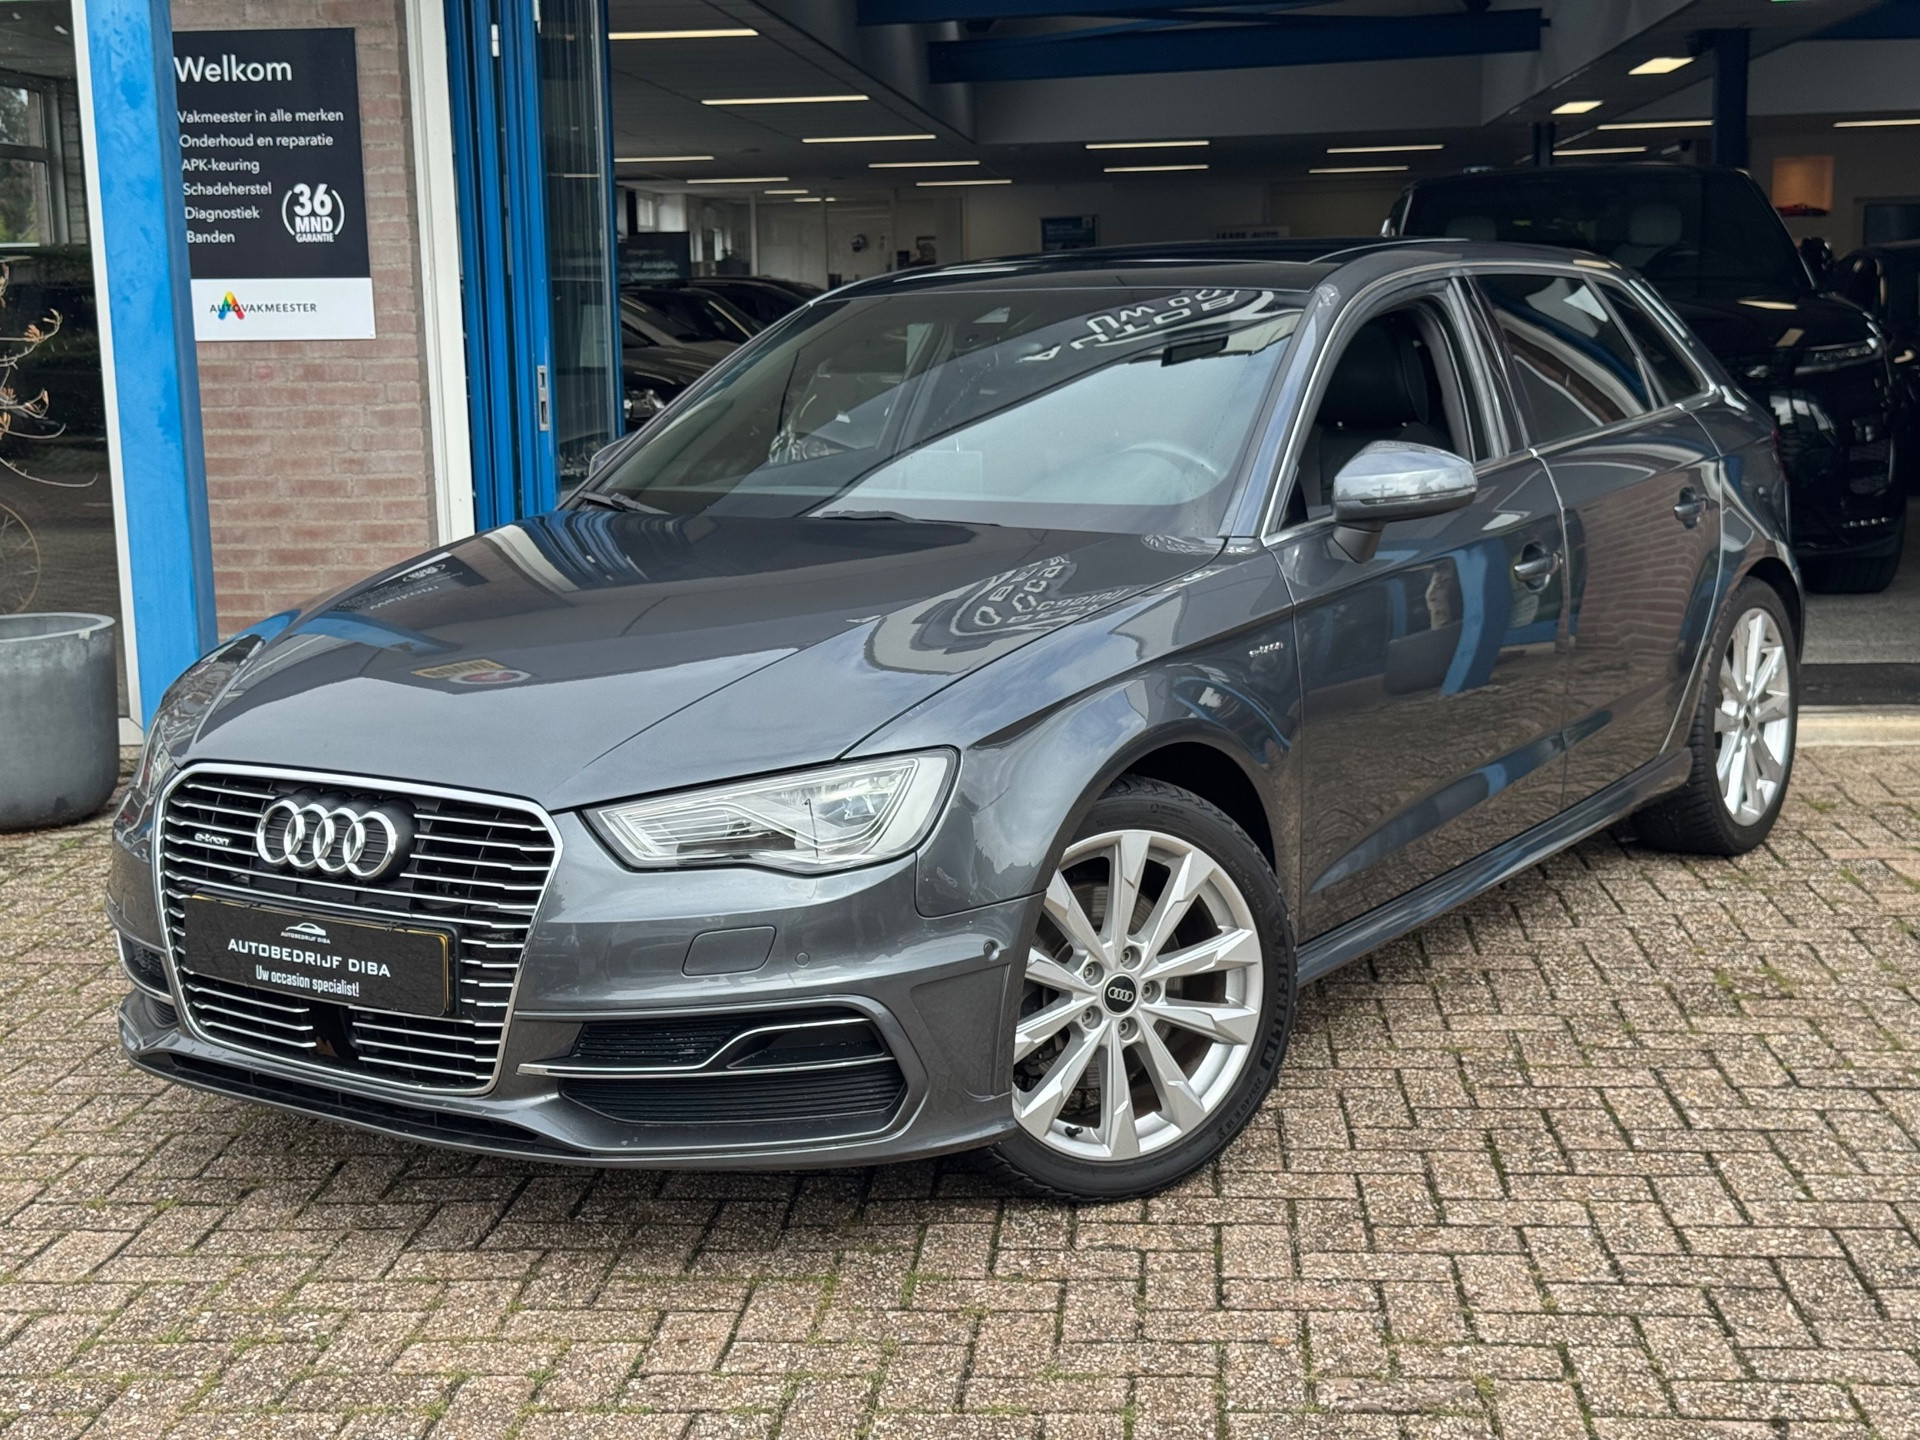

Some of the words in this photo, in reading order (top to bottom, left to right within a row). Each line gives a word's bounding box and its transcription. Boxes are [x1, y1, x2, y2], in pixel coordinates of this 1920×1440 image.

[173, 53, 293, 83] Welkom
[177, 110, 252, 124] Vakmeester
[255, 110, 267, 123] in
[270, 108, 293, 122] alle
[295, 108, 344, 122] merken
[179, 133, 254, 148] Onderhoud
[257, 137, 273, 146] en
[276, 133, 334, 149] reparatie
[181, 158, 260, 174] APK-keuring
[182, 181, 272, 196] Schadeherstel
[293, 183, 333, 216] 36
[184, 205, 260, 223] Diagnostiek
[294, 216, 334, 233] MND
[186, 230, 236, 244] Banden
[295, 233, 335, 243] GARANTIE
[209, 303, 317, 314] AUTOVAKMEESTER
[194, 832, 230, 846] e-tron
[280, 931, 317, 942] AUTOBEDRIJF
[227, 938, 342, 969] AUTOBEDRIJF
[348, 958, 391, 978] DIBA
[255, 965, 270, 982] Uw
[271, 971, 311, 988] occasion
[312, 979, 360, 998] specialist!
